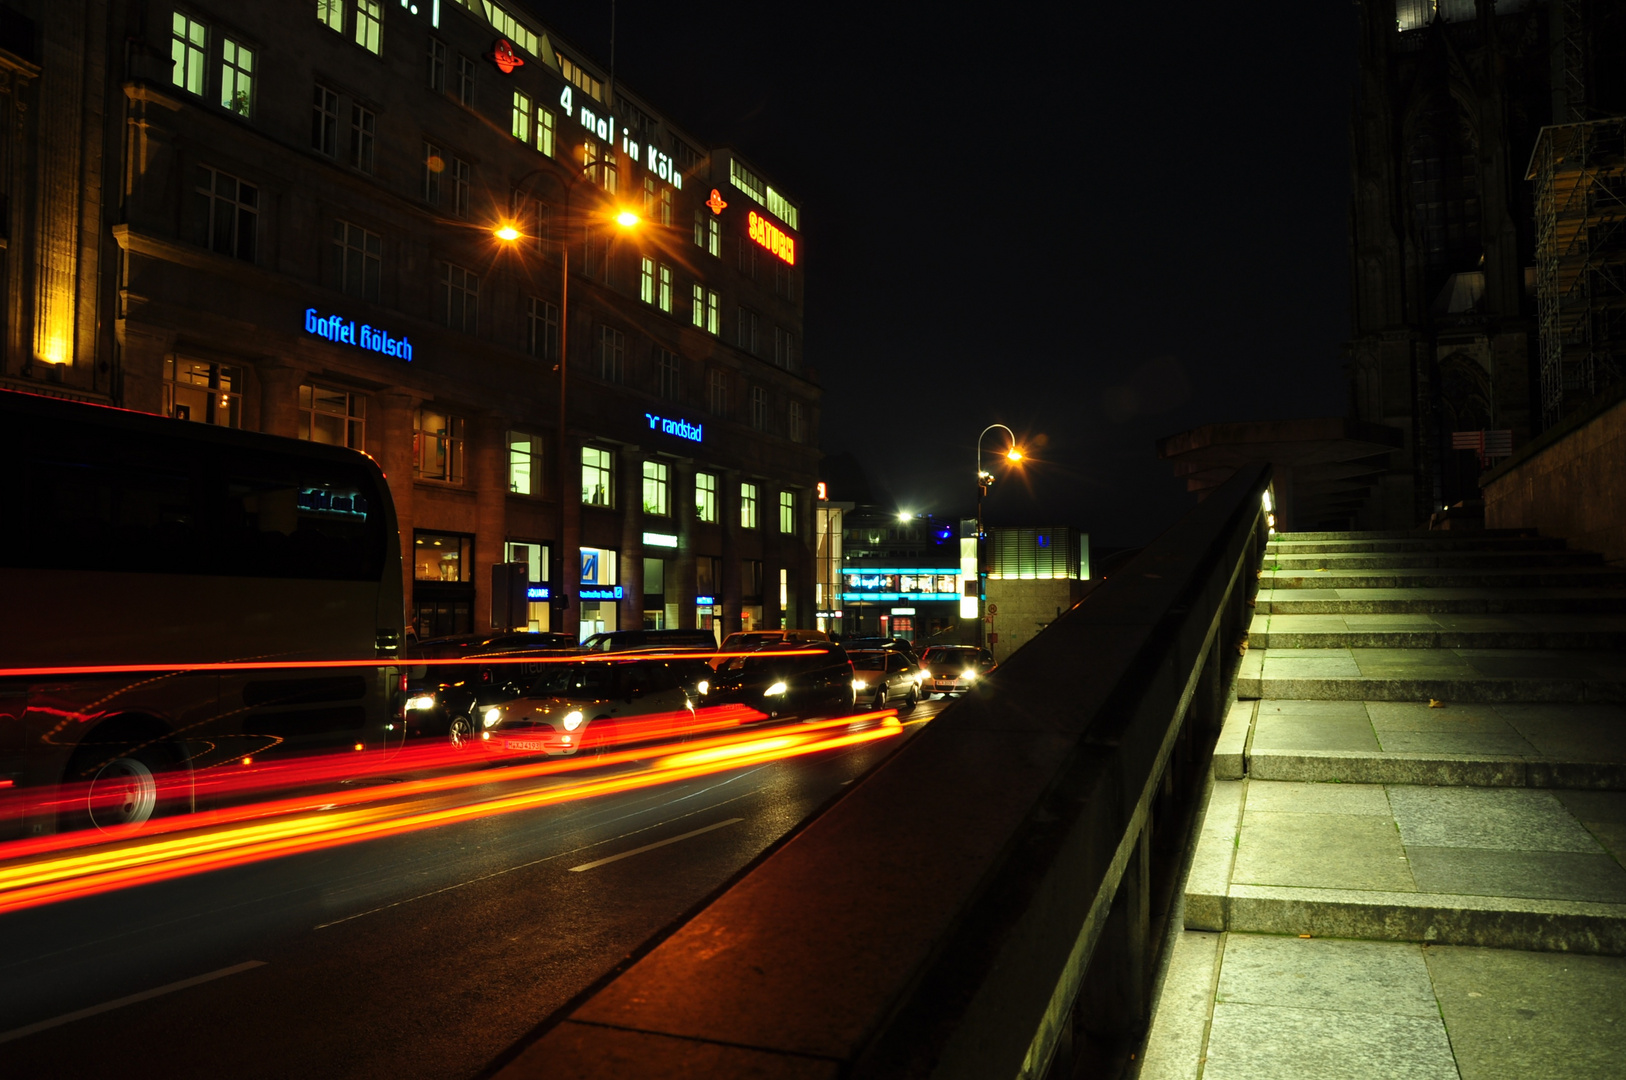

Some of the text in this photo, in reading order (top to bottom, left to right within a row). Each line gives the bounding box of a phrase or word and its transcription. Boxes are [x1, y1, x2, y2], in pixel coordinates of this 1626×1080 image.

[560, 85, 683, 190] 4 mal in Köln
[748, 211, 794, 265] SATURN
[305, 308, 412, 362] Gaffel Kölsch
[662, 418, 702, 442] randstad
[1038, 535, 1049, 547] U
